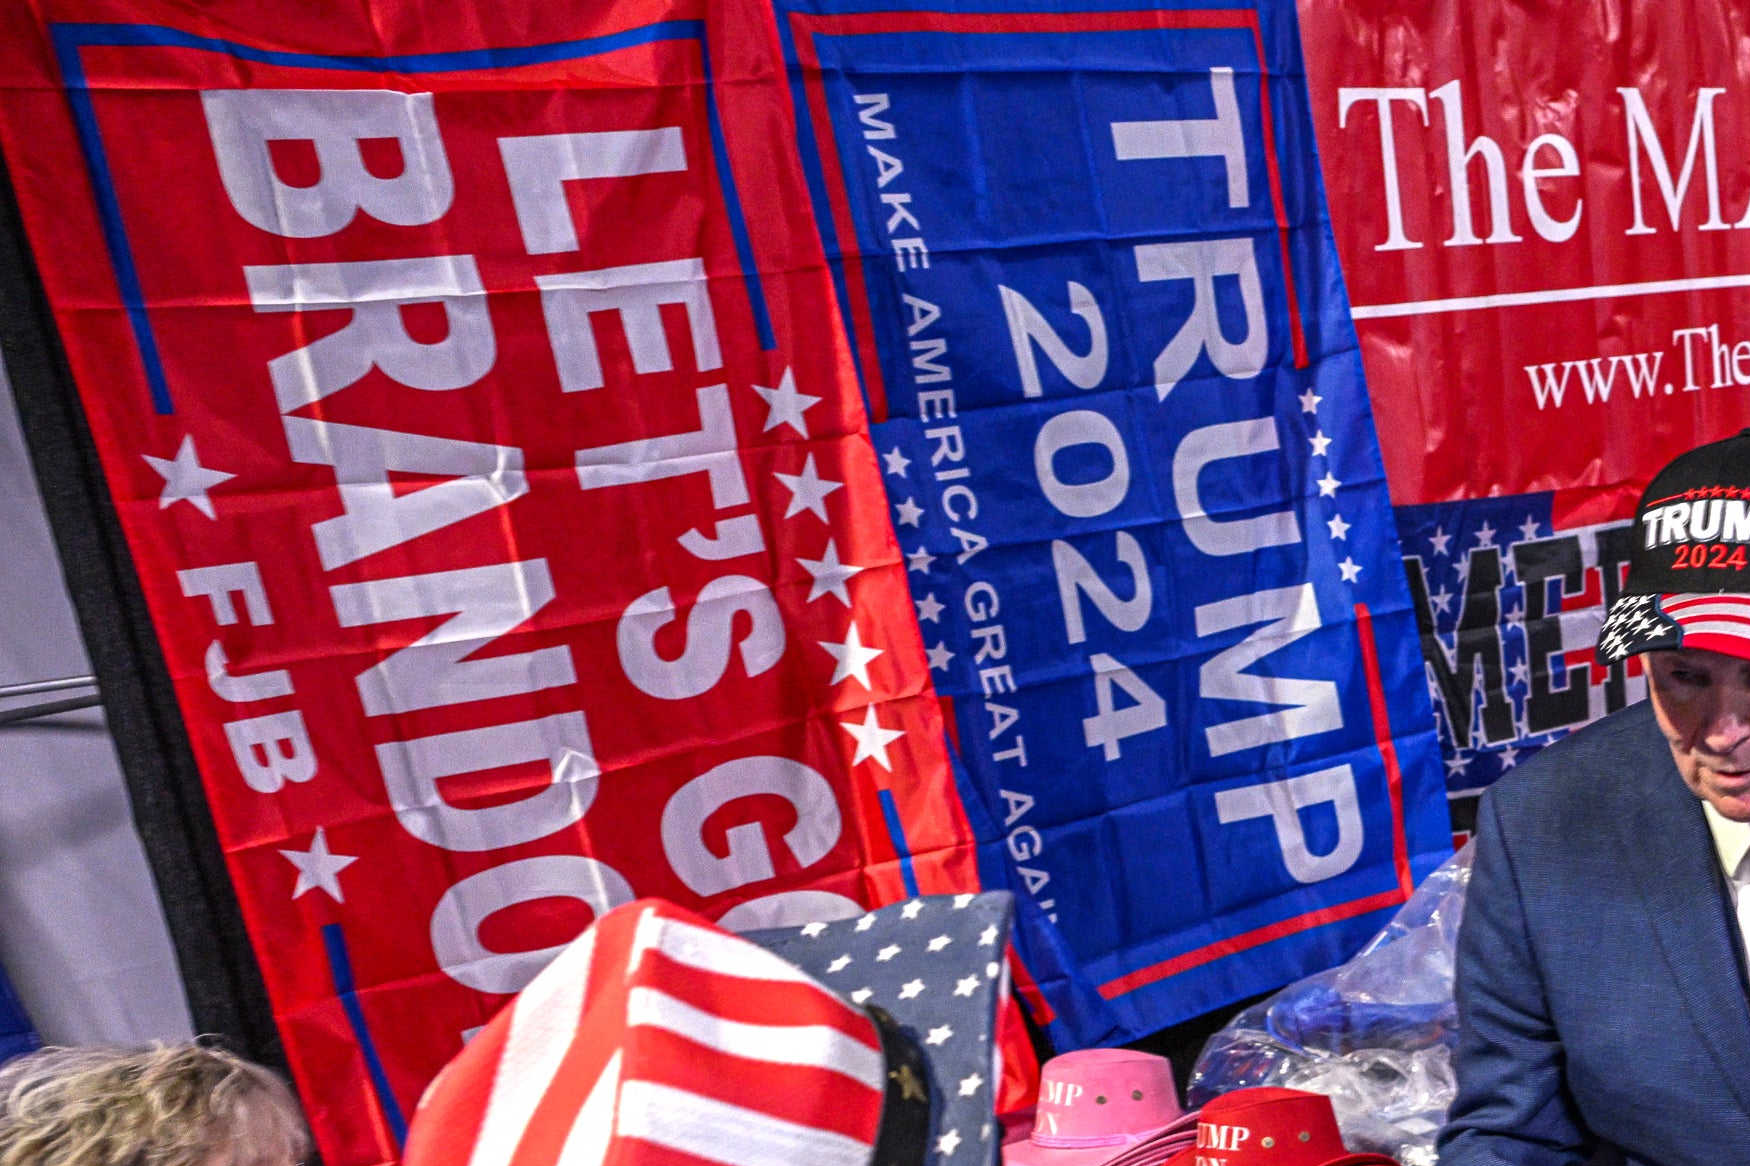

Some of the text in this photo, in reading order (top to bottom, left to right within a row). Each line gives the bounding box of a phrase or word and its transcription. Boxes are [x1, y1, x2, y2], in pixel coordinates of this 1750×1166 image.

[1110, 66, 1364, 884] TRUMP
[1337, 80, 1584, 252] The
[177, 561, 318, 795] FJB
[200, 88, 638, 1045] BRANDO
[497, 126, 868, 932] LET'S G
[853, 92, 1058, 924] MAKE AMERICA GREAT AGA
[998, 280, 1168, 763] 2024
[1672, 544, 1748, 572] 2024
